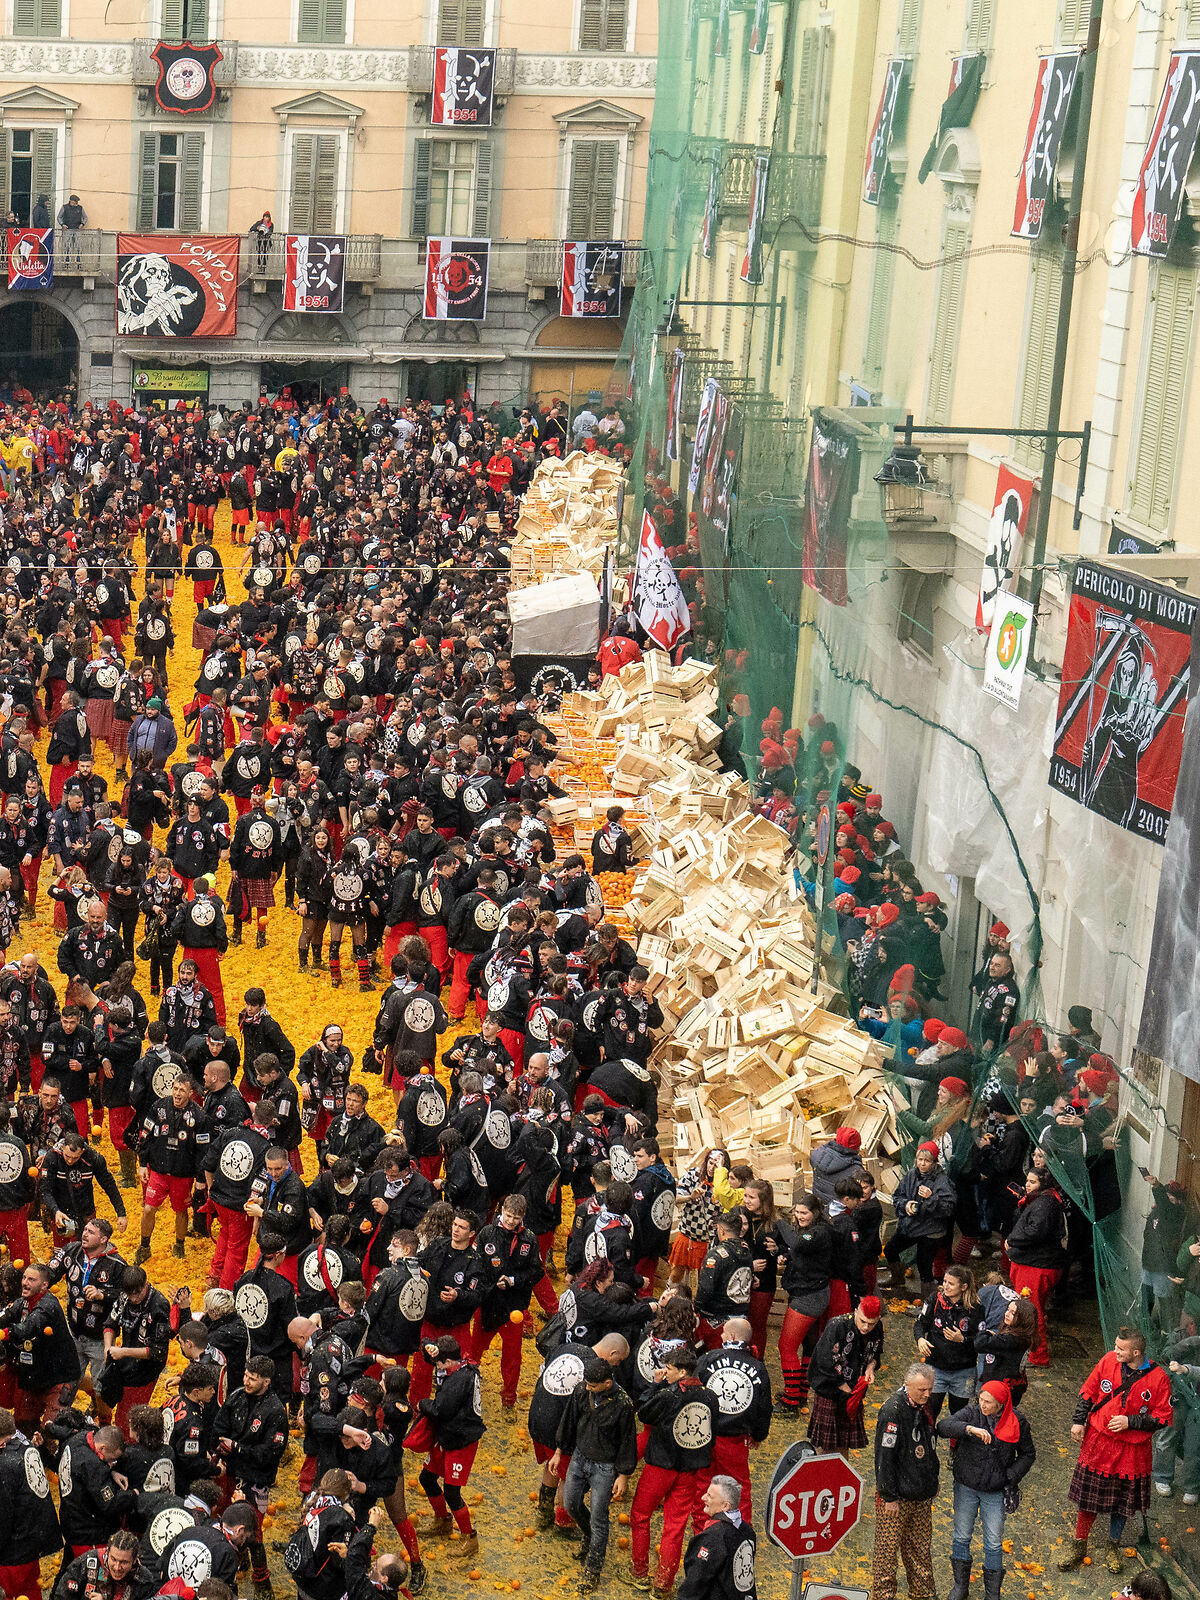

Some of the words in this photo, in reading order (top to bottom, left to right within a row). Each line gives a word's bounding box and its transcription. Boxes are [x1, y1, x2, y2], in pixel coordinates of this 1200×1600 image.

[447, 109, 477, 121] 1954
[16, 257, 45, 270] Violetta
[180, 242, 234, 282] FONDO
[187, 259, 227, 312] PIAZZA
[467, 274, 483, 286] 54
[299, 295, 329, 308] 1954
[576, 300, 607, 313] 1954
[1075, 566, 1135, 605] PERICOLO
[1138, 588, 1153, 612] DI
[1156, 595, 1197, 626] MORT
[1054, 763, 1077, 792] 1954
[706, 1357, 762, 1386] VINCENT
[730, 1401, 748, 1413] Morte
[452, 1462, 463, 1472] 10
[777, 1485, 856, 1530] STOP
